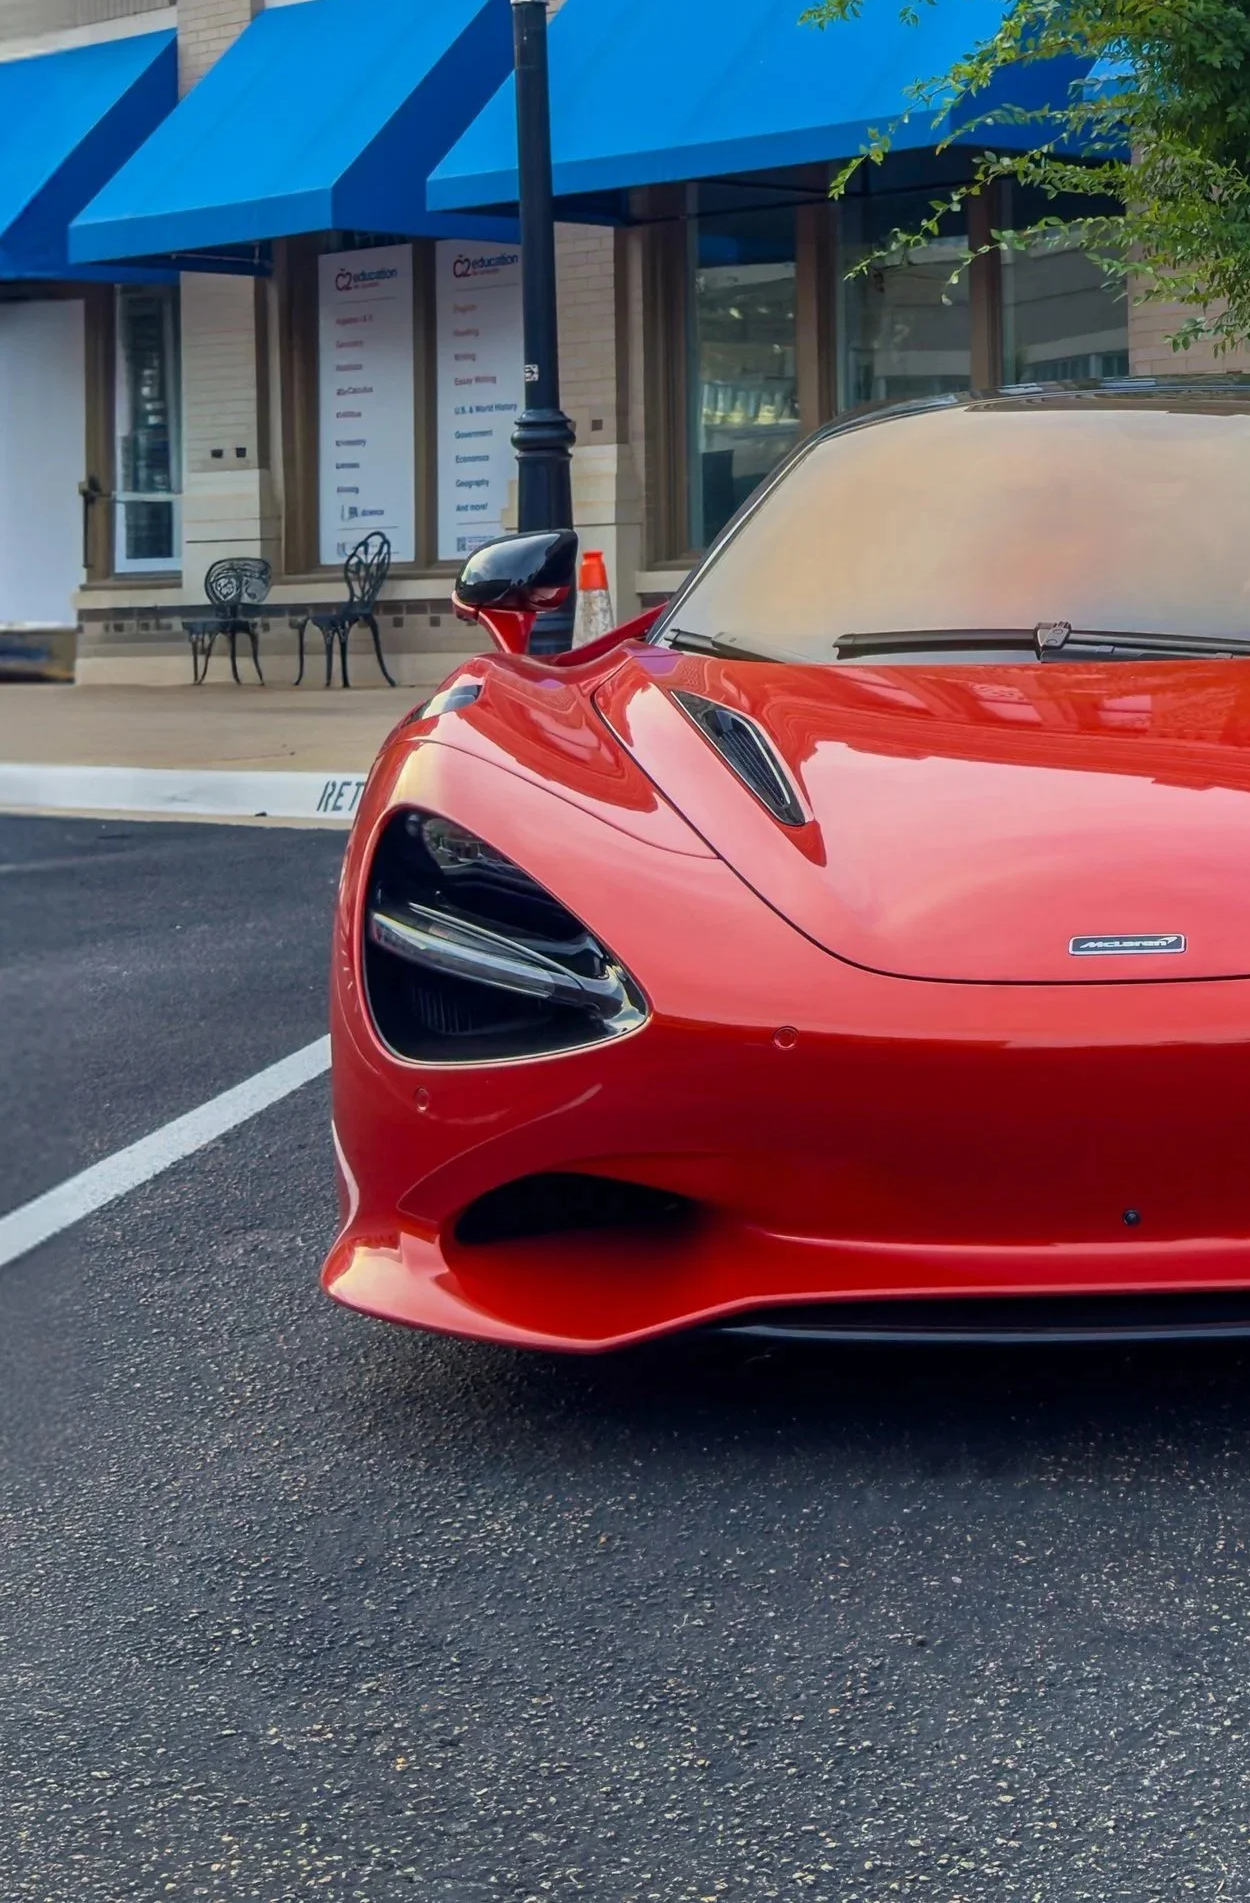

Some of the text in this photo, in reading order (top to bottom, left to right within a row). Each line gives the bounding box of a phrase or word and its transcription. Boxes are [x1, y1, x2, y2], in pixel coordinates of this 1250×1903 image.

[472, 253, 519, 269] education
[353, 267, 398, 283] education
[475, 403, 493, 413] World
[494, 402, 518, 412] History
[455, 429, 493, 440] Government
[455, 454, 490, 464] Economics
[455, 478, 490, 489] Geography
[456, 502, 468, 512] And
[316, 780, 366, 812] RET
[1080, 937, 1173, 948] McLaren
